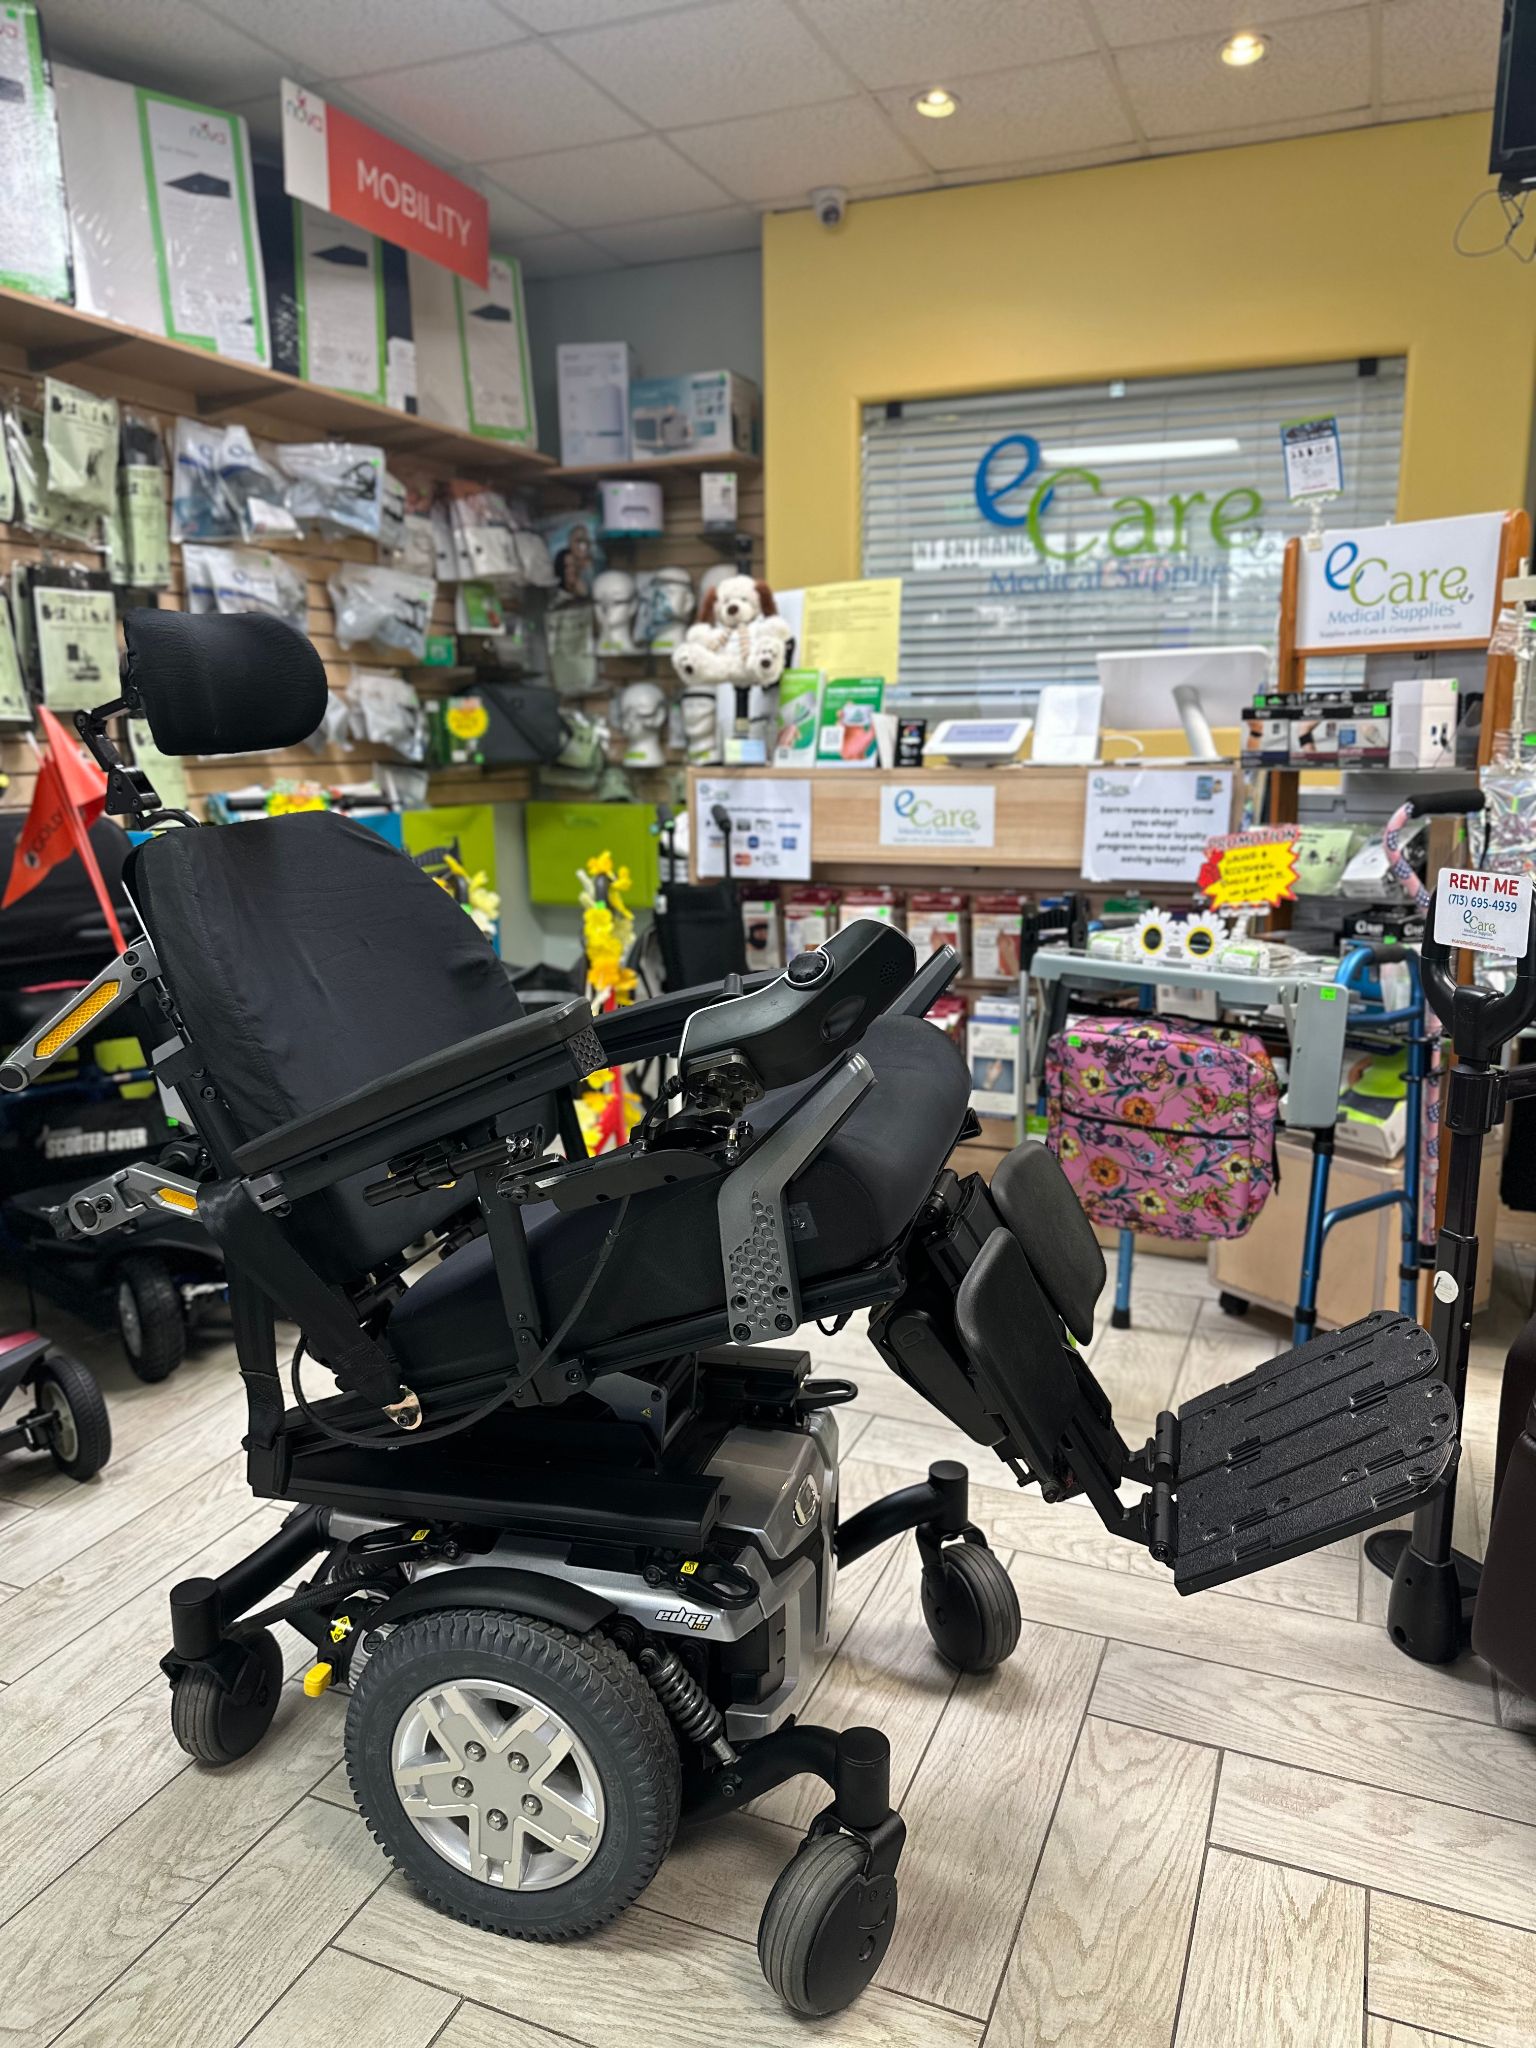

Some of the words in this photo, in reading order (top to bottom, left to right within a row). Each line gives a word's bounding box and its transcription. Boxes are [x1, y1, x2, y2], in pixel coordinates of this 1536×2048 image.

[356, 157, 471, 248] MOBILITY
[975, 434, 1263, 561] eCare
[987, 562, 1099, 595] Medical
[1324, 541, 1467, 607] eCare
[1327, 606, 1385, 625] Medical
[1391, 603, 1455, 622] Supplies
[1363, 627, 1379, 636] Care
[894, 789, 976, 829] eCare
[1100, 806, 1121, 814] Earn
[1123, 806, 1160, 815] rewards
[1163, 808, 1189, 817] every
[1192, 807, 1215, 815] time
[1132, 820, 1149, 828] you
[1104, 830, 1120, 839] Ask
[1136, 831, 1155, 839] how
[1174, 831, 1207, 842] loyalty
[1096, 843, 1137, 854] program
[1139, 843, 1167, 852] works
[1169, 843, 1188, 852] and
[1121, 856, 1152, 866] saving
[1449, 873, 1491, 892] RENT
[1493, 877, 1520, 896] ME
[1448, 893, 1469, 907] (713)
[1470, 896, 1517, 912] 695-4939
[1463, 909, 1496, 932] eCare
[45, 1131, 106, 1159] SCOOTER
[107, 1127, 147, 1151] COVER
[655, 1607, 713, 1630] edge
